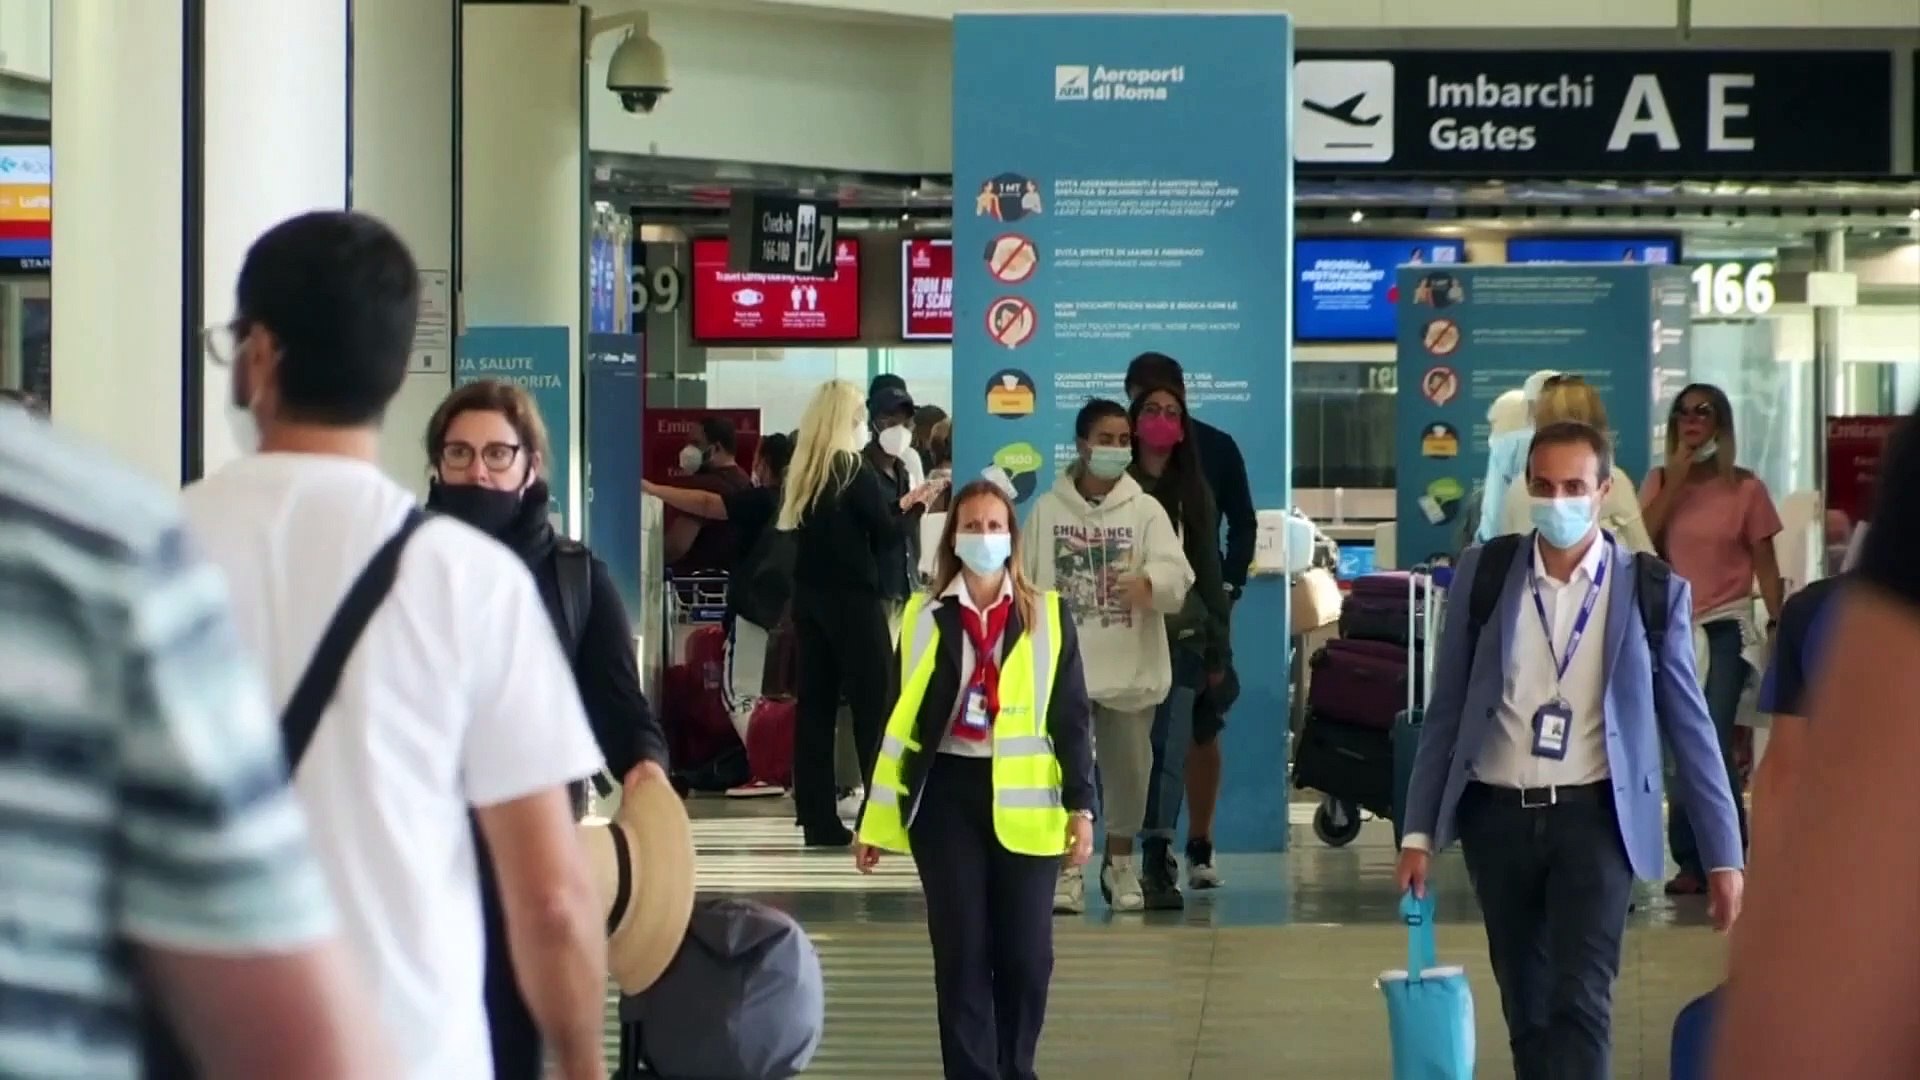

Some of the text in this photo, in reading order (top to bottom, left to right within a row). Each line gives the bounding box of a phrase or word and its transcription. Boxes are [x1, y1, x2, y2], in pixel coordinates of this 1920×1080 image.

[1092, 65, 1185, 85] Aeroporti
[1092, 84, 1168, 101] di Roma
[1428, 74, 1755, 151] Imbarchi A E
[1429, 118, 1537, 151] Gates
[1000, 183, 1021, 193] 1 MT
[912, 277, 940, 293] ZOOM
[1691, 262, 1776, 315] 166
[912, 292, 925, 308] TO
[479, 356, 534, 370] SALUTE
[1053, 524, 1133, 538] CHILL SINCE
